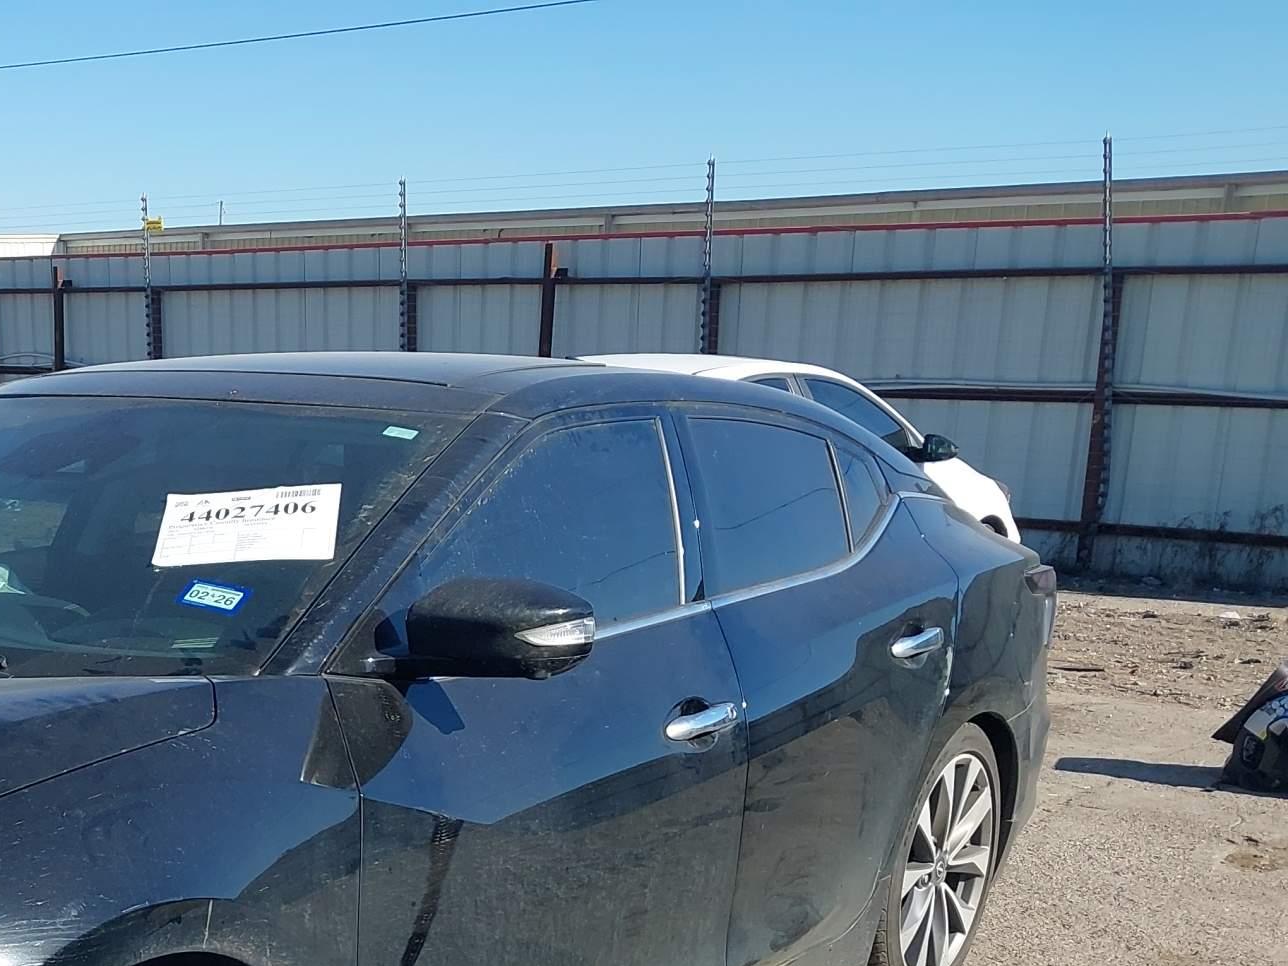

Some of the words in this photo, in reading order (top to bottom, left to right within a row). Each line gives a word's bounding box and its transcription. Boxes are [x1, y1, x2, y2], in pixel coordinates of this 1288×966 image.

[180, 500, 317, 523] 44027406
[188, 589, 210, 600] 02
[213, 594, 236, 606] 26
